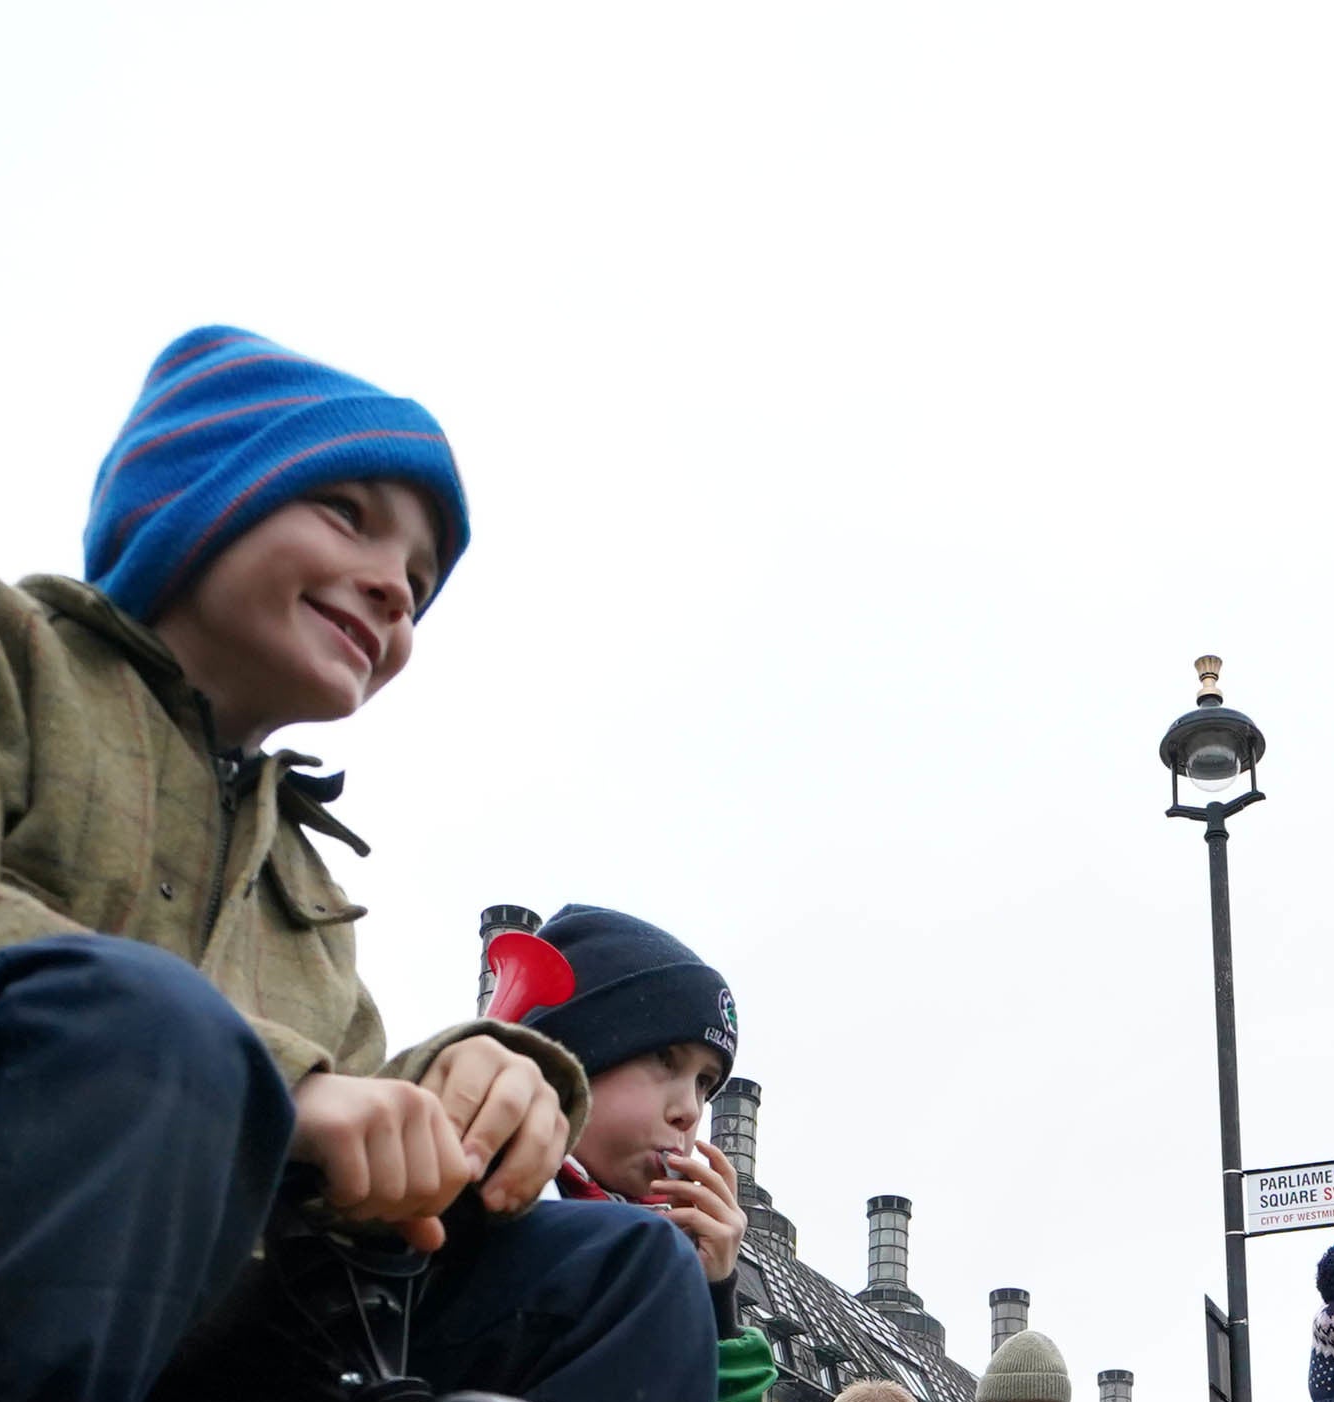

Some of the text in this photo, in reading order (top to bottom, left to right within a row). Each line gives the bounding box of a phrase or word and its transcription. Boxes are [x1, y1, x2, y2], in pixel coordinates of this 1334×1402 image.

[1260, 1189, 1318, 1208] SQUARE
[1260, 1215, 1280, 1226] CITY
[1283, 1213, 1295, 1223] OF
